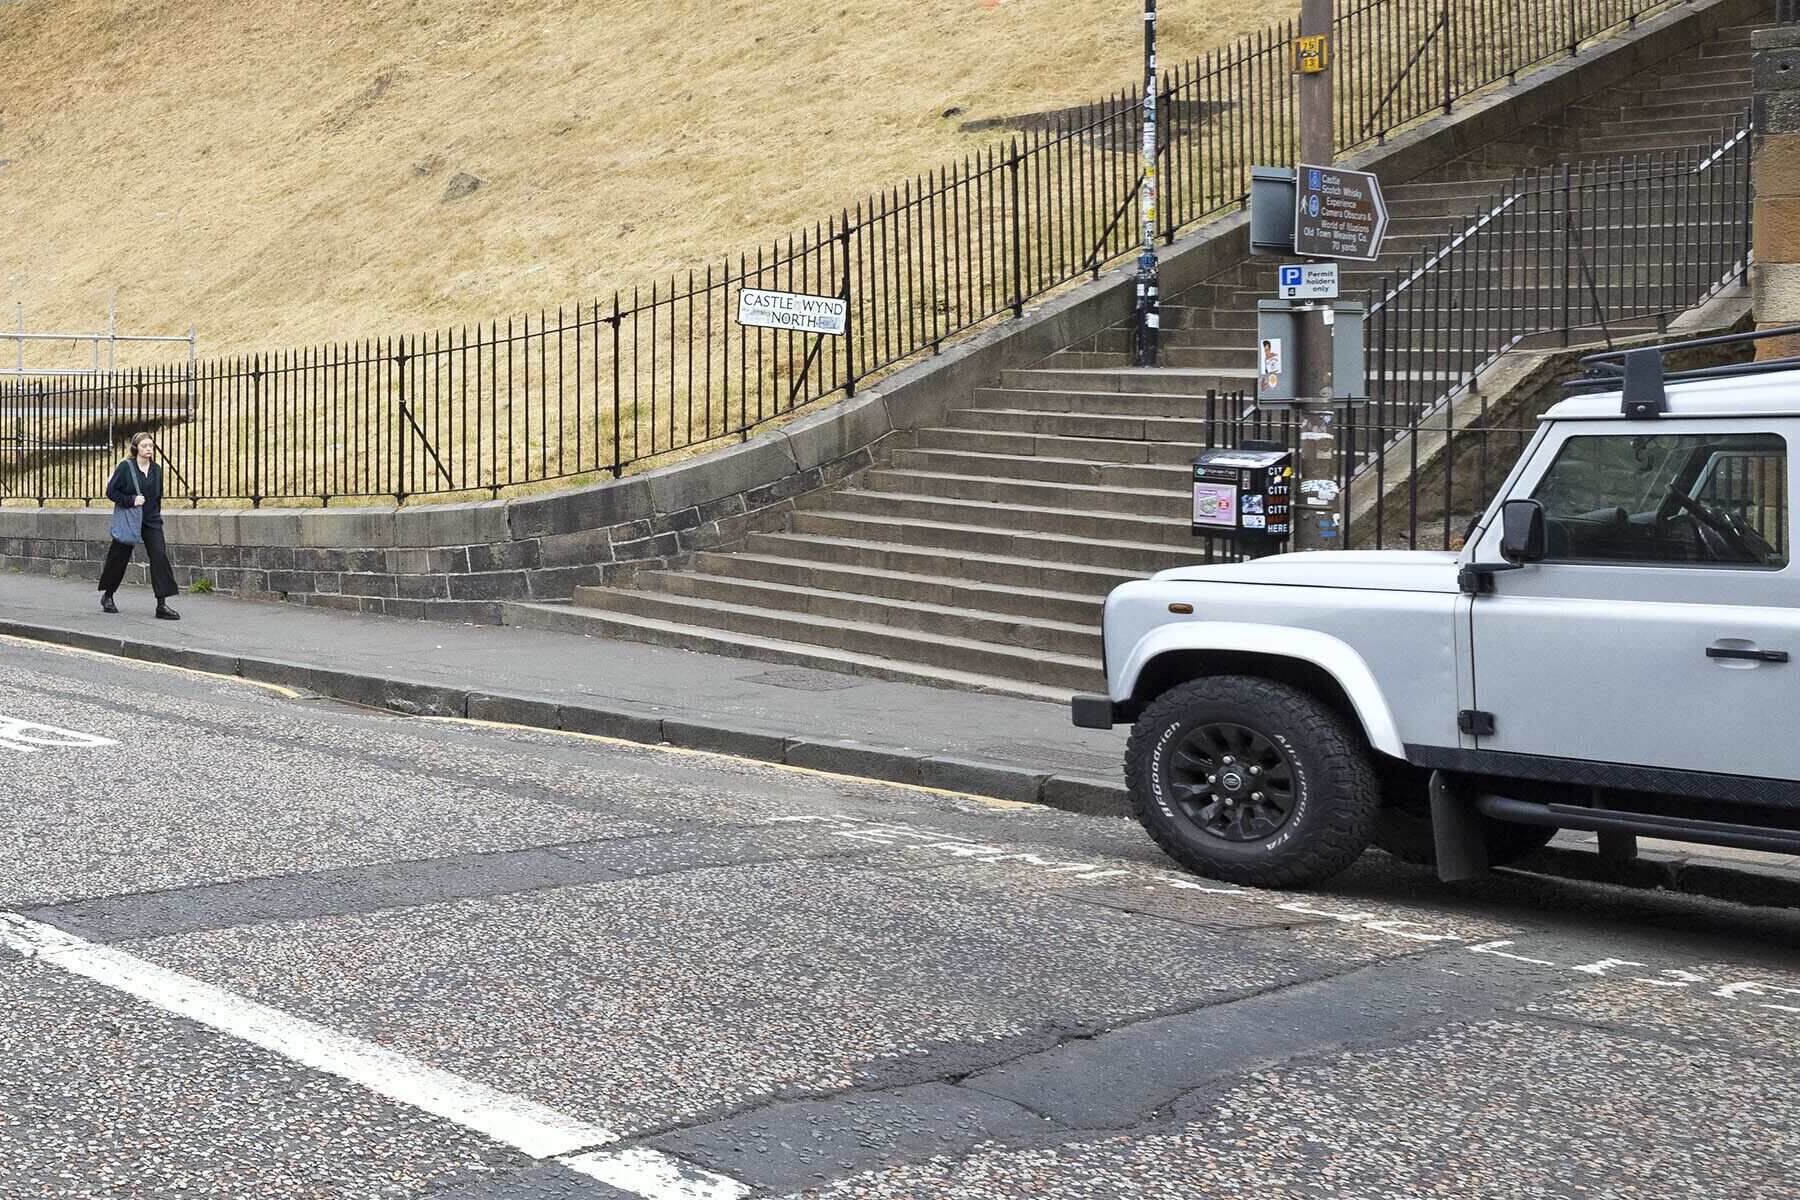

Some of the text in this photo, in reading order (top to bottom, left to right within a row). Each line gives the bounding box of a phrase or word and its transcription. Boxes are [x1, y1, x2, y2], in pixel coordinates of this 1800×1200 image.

[1321, 174, 1340, 185] Castle
[1321, 184, 1362, 199] Scotch Whisky
[1326, 196, 1357, 208] Experience
[1320, 207, 1372, 221] Camera Obscura &
[1320, 220, 1370, 233] World of Illusions
[1303, 227, 1315, 236] Old
[1316, 228, 1332, 238] Town
[1332, 230, 1357, 242] Weaving
[1331, 241, 1358, 252] 70 yards
[1286, 268, 1300, 284] P
[1312, 284, 1329, 293] only
[743, 293, 844, 316] CASTLE WYND
[771, 311, 817, 328] NORTH
[1268, 466, 1285, 476] CIT
[1268, 485, 1288, 495] CITY
[1268, 505, 1288, 514] CITY
[1267, 524, 1288, 533] HERE
[1151, 721, 1181, 818] BFGoodrich
[1265, 832, 1292, 851] T/A
